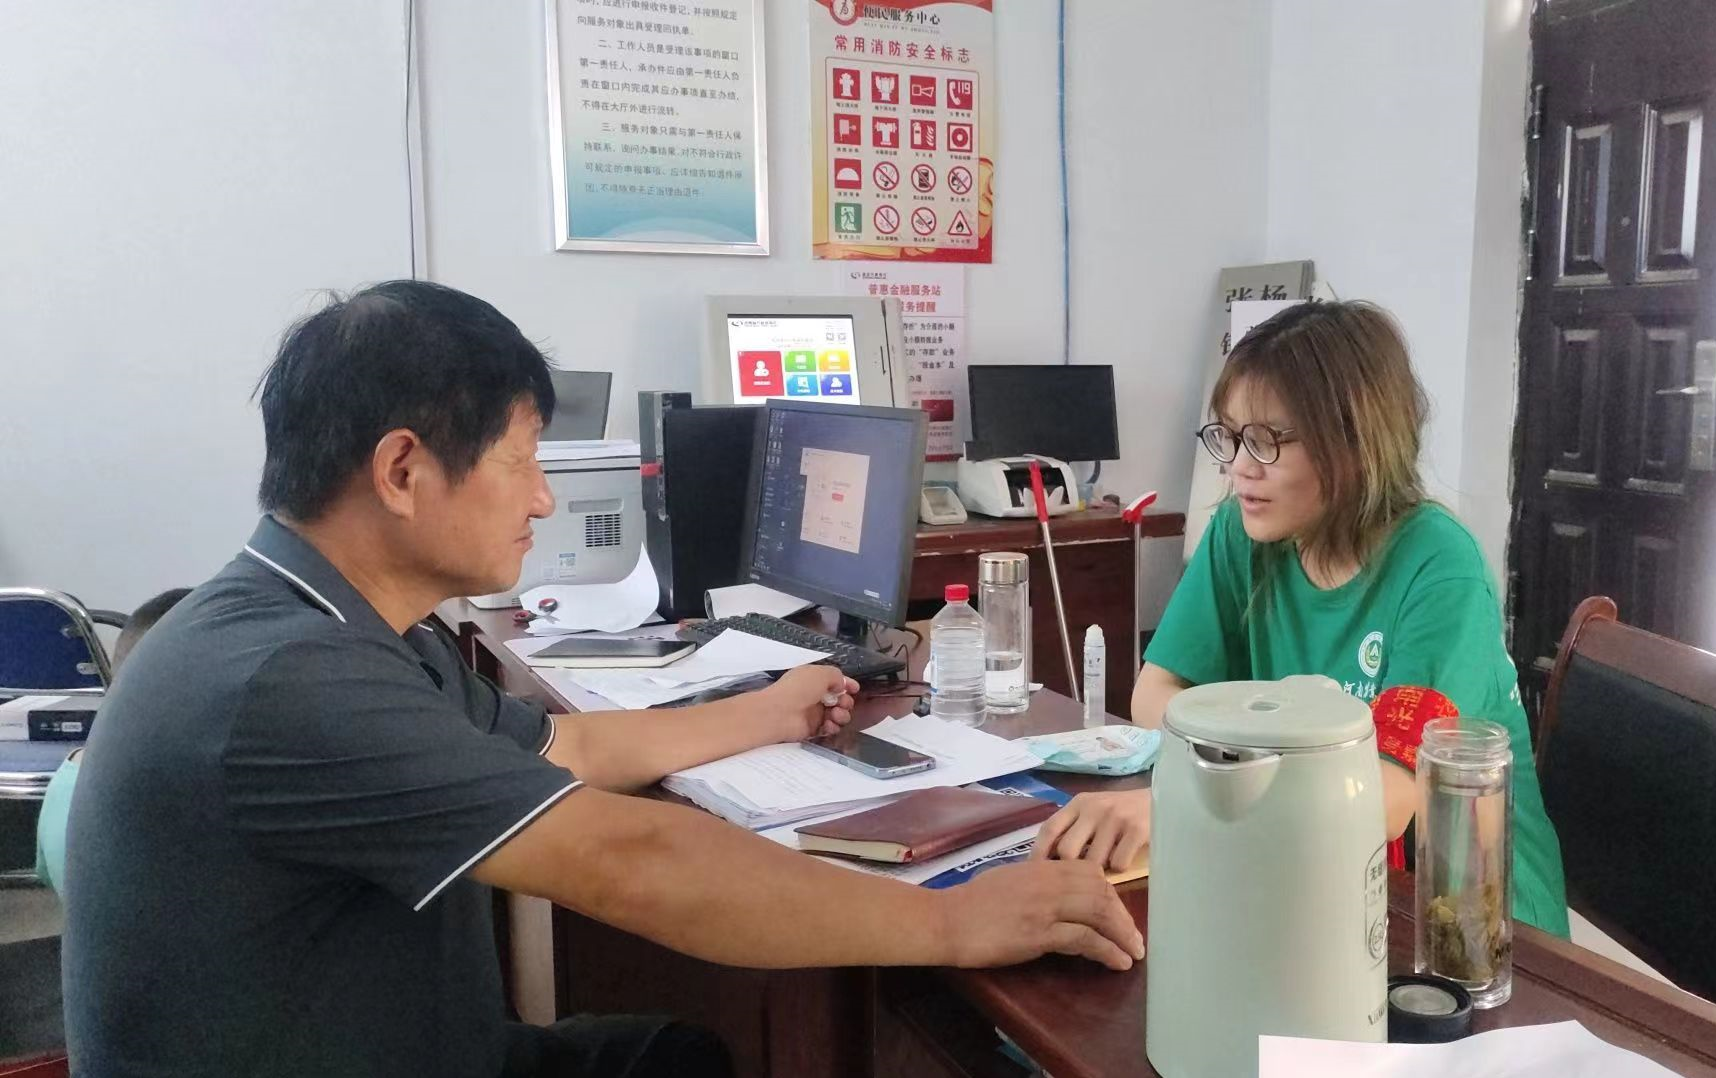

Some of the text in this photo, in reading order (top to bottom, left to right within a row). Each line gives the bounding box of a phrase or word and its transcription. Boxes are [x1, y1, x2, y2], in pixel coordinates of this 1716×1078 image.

[864, 5, 940, 25] 便民服务中心
[834, 34, 970, 64] 常用消防安全标志
[957, 81, 971, 94] 119
[868, 284, 941, 297] 普惠金融服务站
